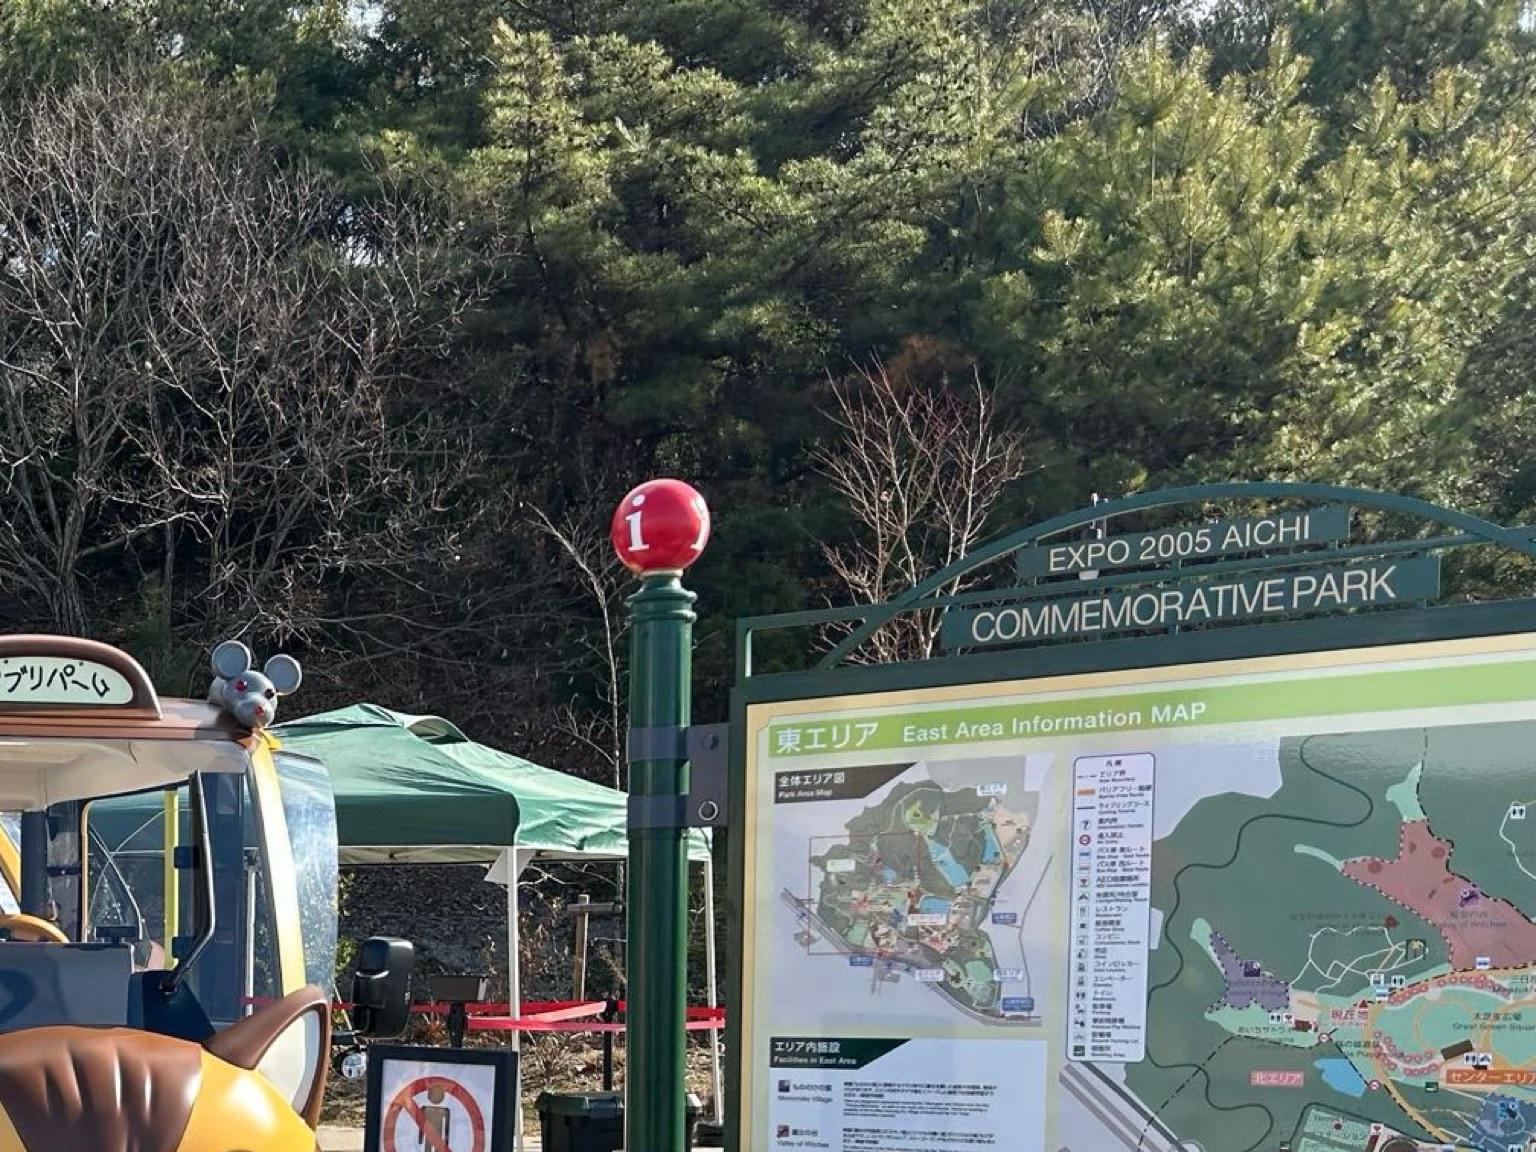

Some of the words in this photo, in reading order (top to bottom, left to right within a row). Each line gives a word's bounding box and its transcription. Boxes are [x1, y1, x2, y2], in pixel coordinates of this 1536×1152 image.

[1049, 541, 1130, 572] EXPO
[1139, 529, 1212, 560] 2005
[1221, 515, 1310, 551] AICHI
[971, 578, 1285, 643] COMMEMORATIVE
[1292, 565, 1396, 608] PARK
[776, 722, 878, 755] 東エリア
[902, 725, 947, 744] East
[955, 720, 1004, 740] Area
[1012, 708, 1142, 735] Information
[1151, 702, 1207, 723] MAP
[779, 772, 845, 787] 全体エリア図
